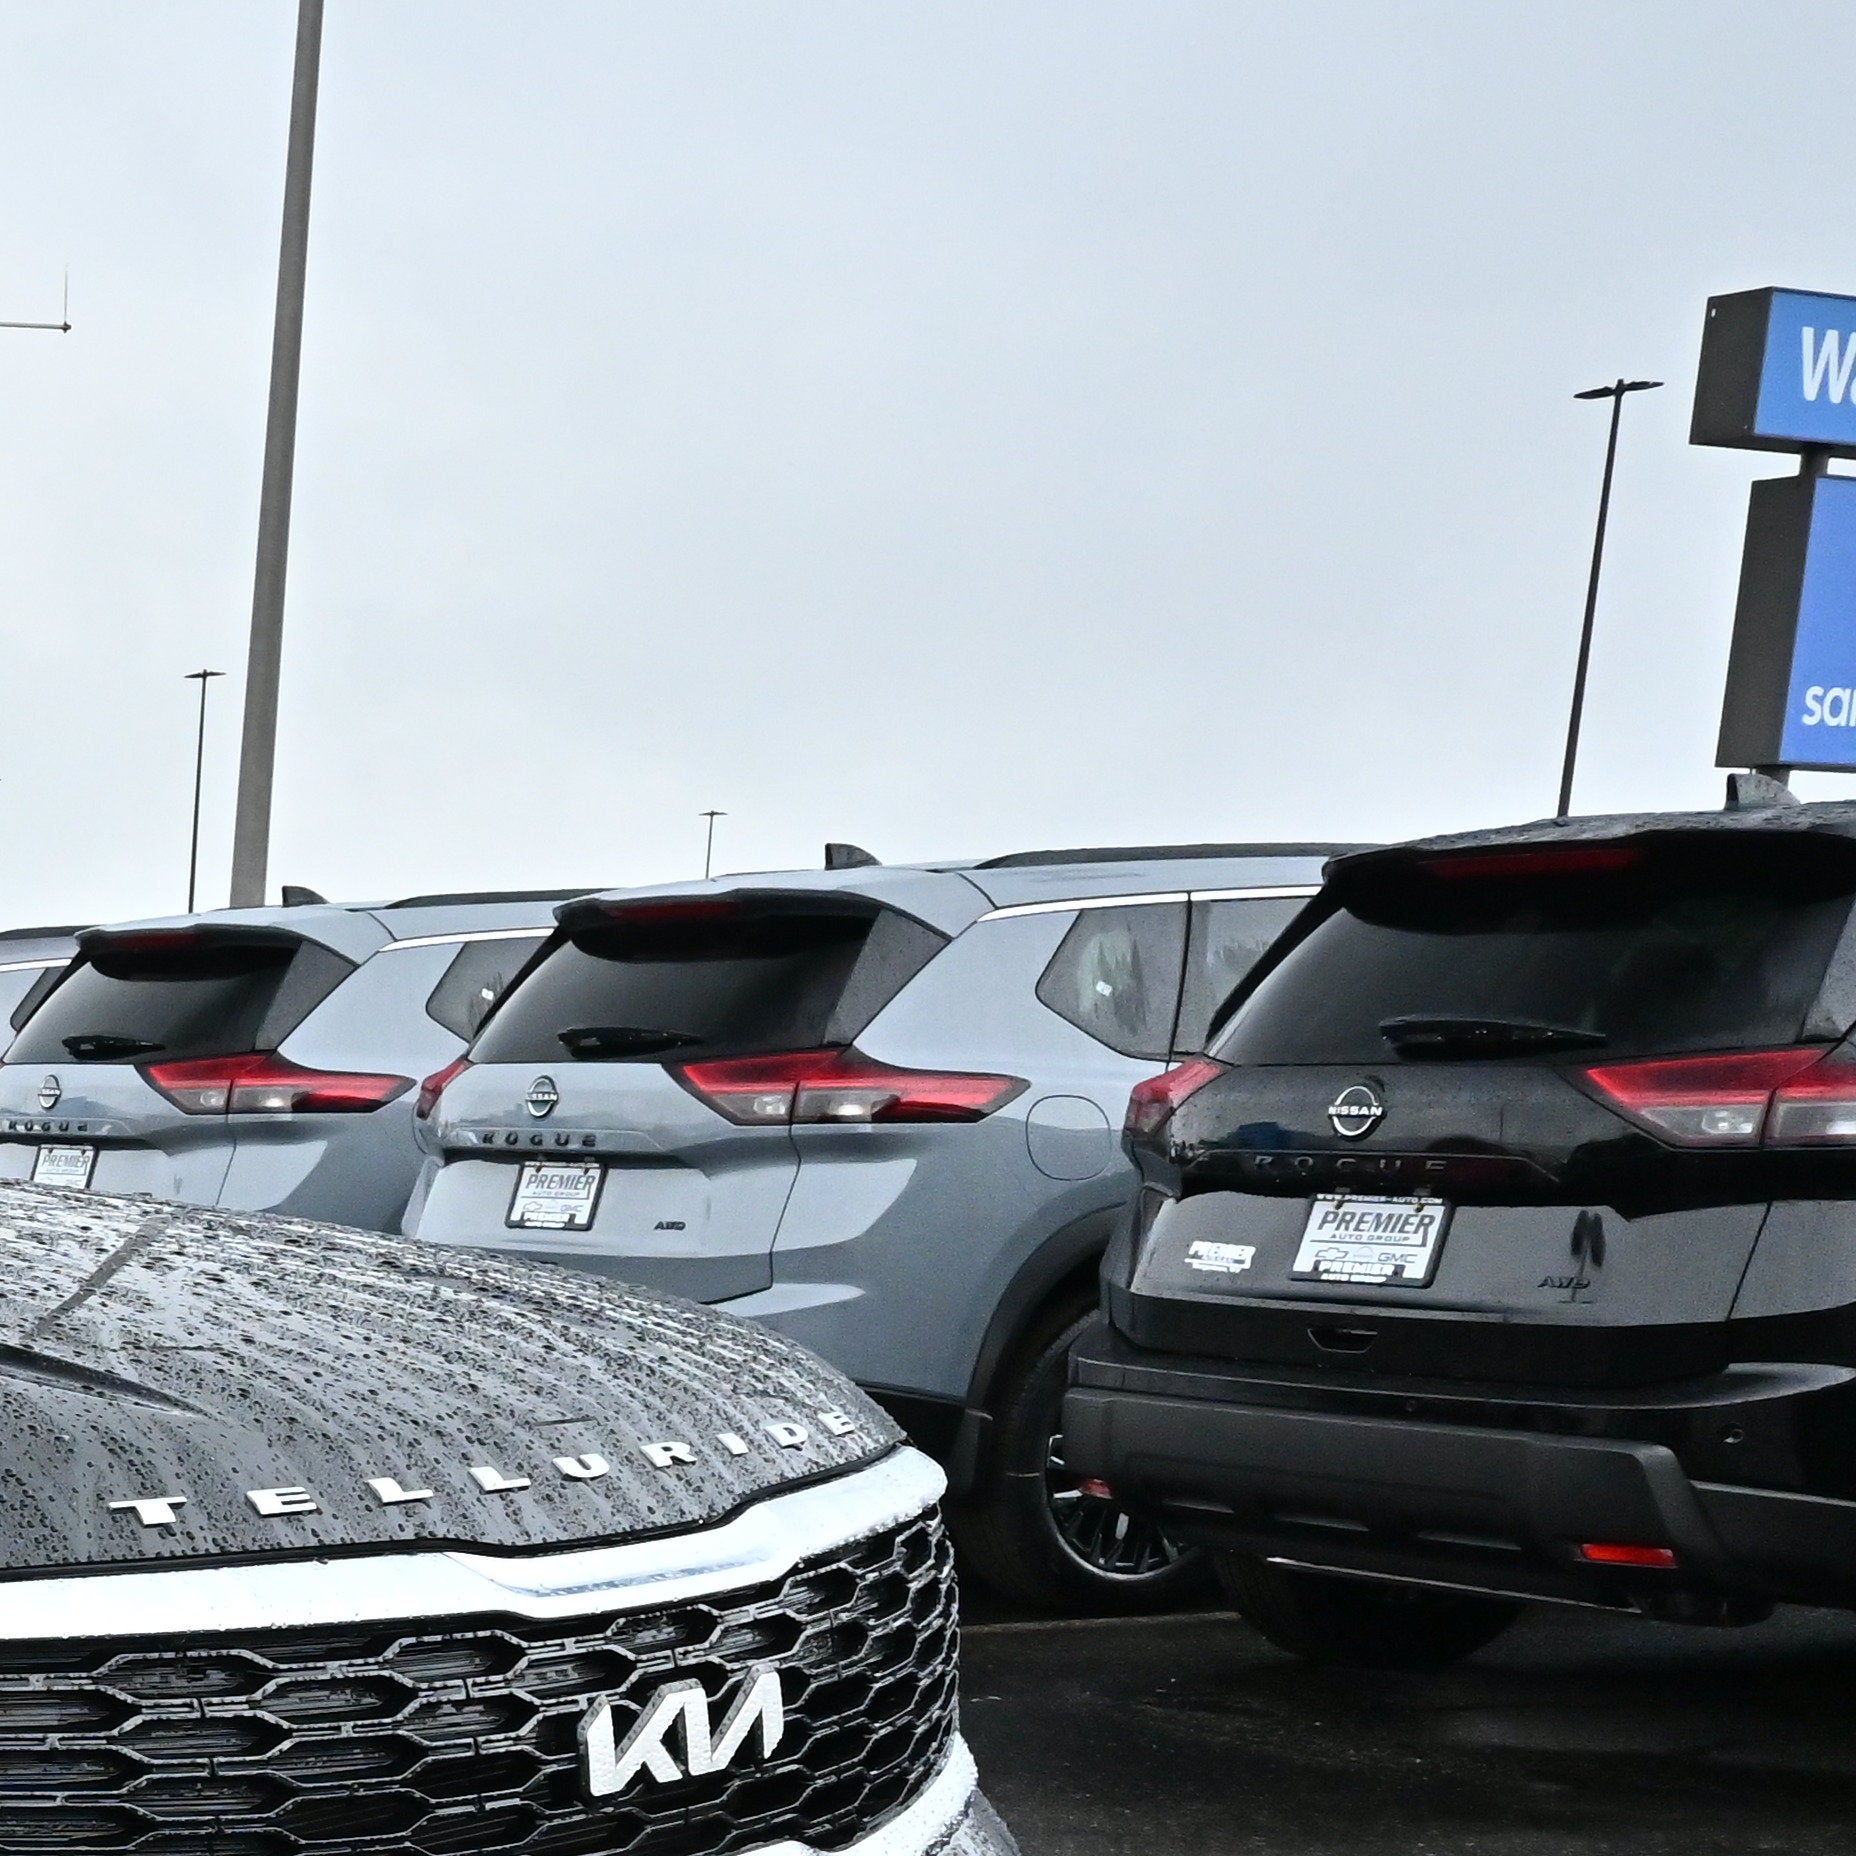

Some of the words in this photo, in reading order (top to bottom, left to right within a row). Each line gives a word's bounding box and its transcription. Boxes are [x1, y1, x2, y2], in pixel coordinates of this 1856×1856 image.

[1802, 326, 1856, 405] W
[1802, 685, 1856, 727] sa
[1328, 1105, 1383, 1116] NISSAN
[482, 1131, 597, 1147] ROGUE
[42, 1154, 90, 1168] PREMIER
[1253, 1154, 1448, 1170] ROGUE
[526, 1174, 596, 1191] PREMIER
[1317, 1210, 1436, 1235] PREMIER
[1329, 1233, 1363, 1241] AUTO
[1367, 1234, 1410, 1242] GROUP
[1378, 1252, 1418, 1264] GMC
[109, 1410, 857, 1528] TELLURIDE
[577, 1662, 786, 1799] KIA
